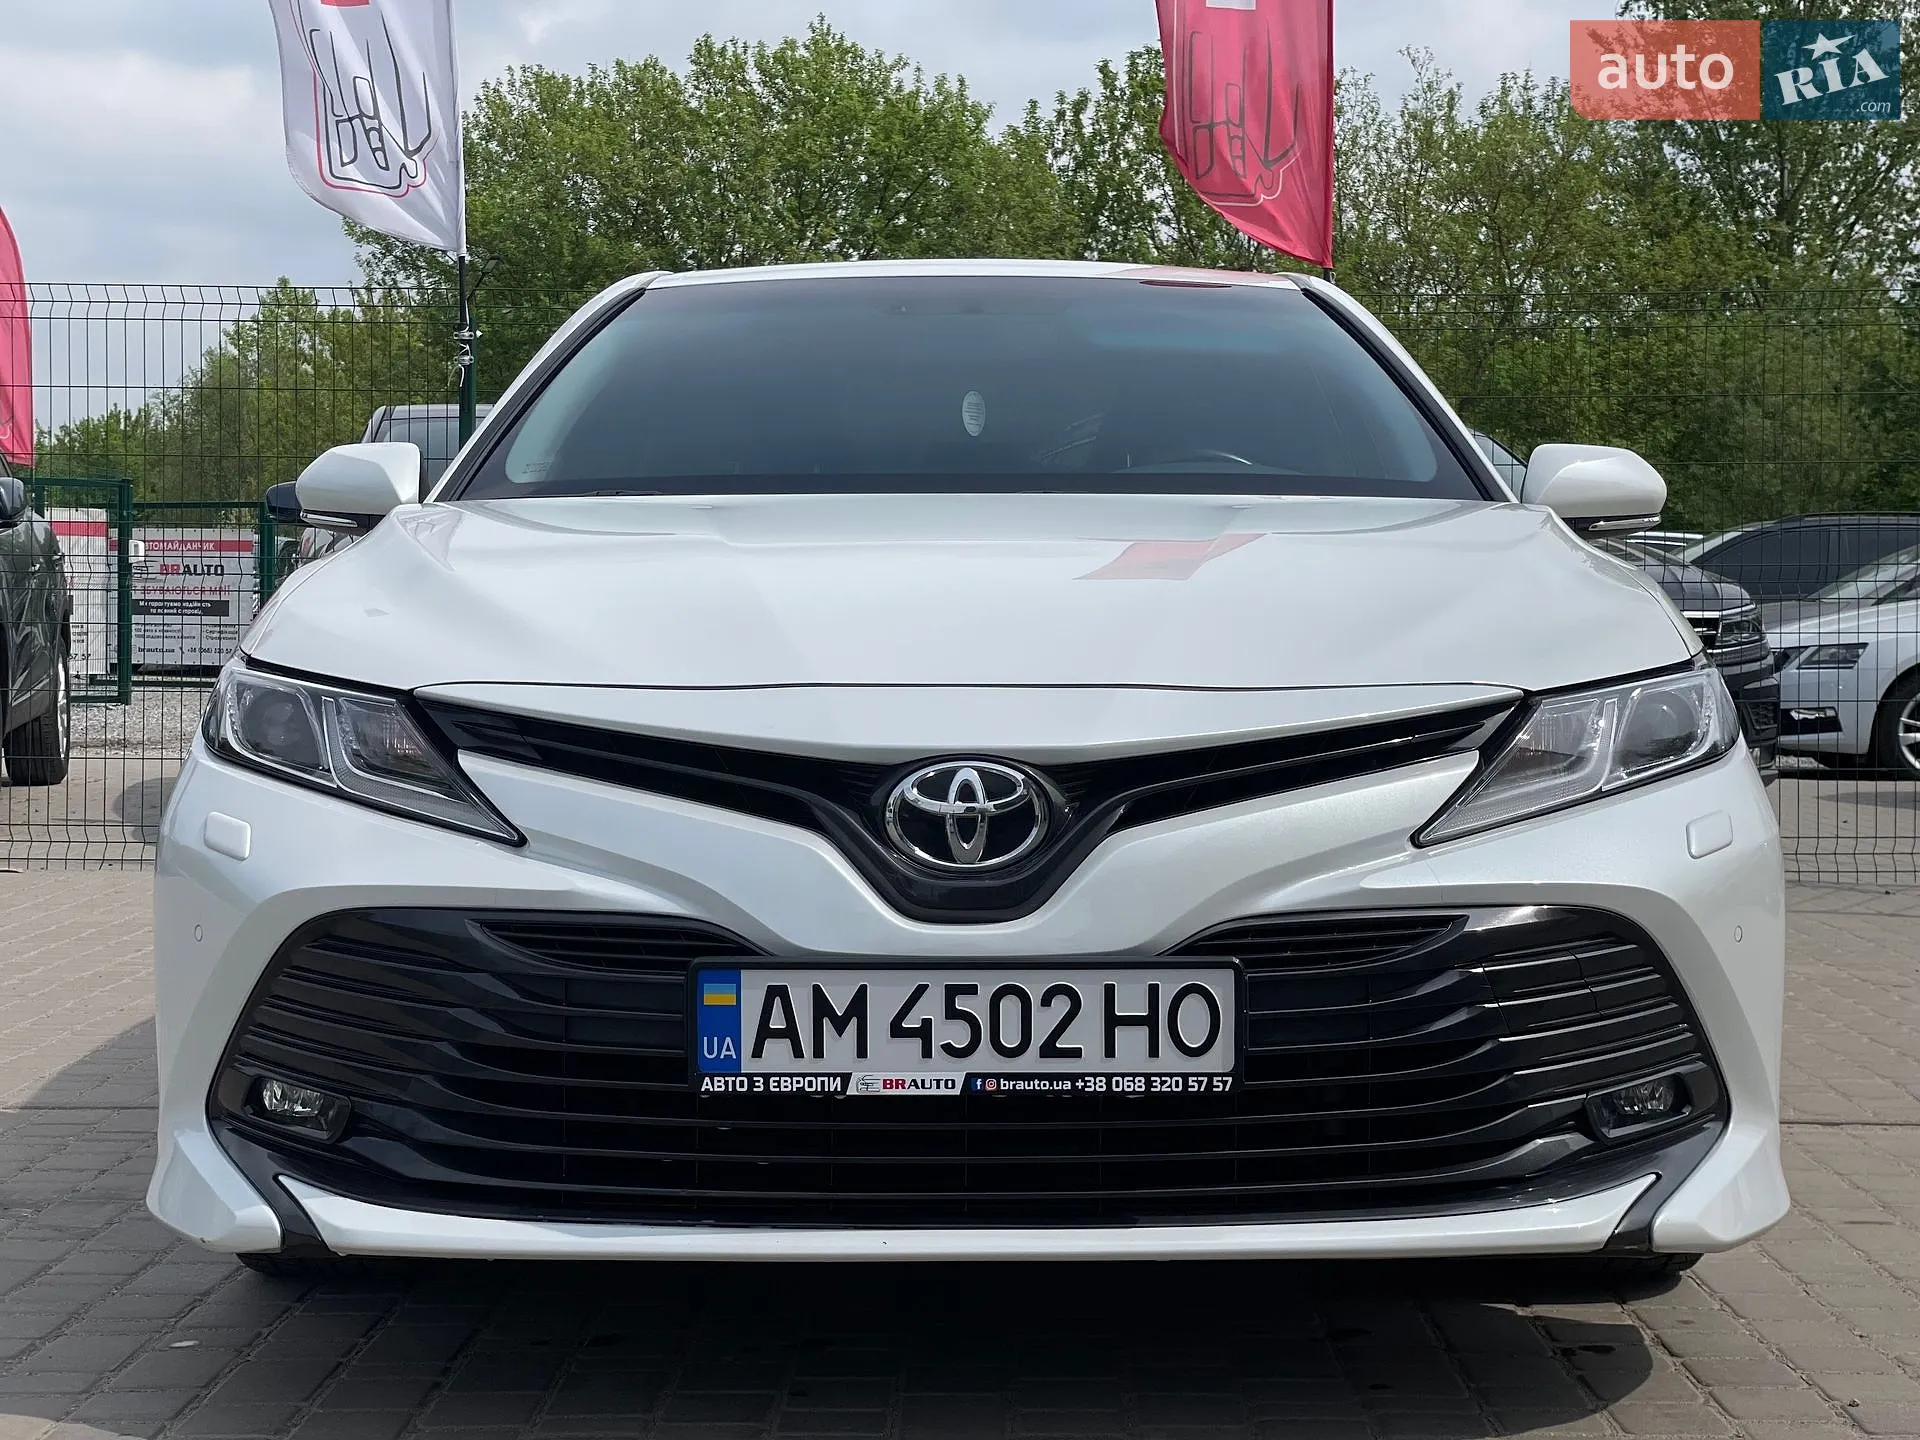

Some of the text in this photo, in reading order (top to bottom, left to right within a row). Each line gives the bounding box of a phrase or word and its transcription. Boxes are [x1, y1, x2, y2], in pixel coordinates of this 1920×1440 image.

[145, 541, 215, 551] ВТОМАЙДАНЧИК
[159, 564, 225, 576] BRAUTO
[751, 982, 1222, 1059] AM 4502 HO
[702, 1037, 737, 1059] UA
[701, 1076, 748, 1092] АВТО
[769, 1076, 841, 1092] ЄВРОПИ
[882, 1078, 956, 1090] BRAUTO
[1000, 1076, 1233, 1092] brauto.ua +38 068 320 57 57
